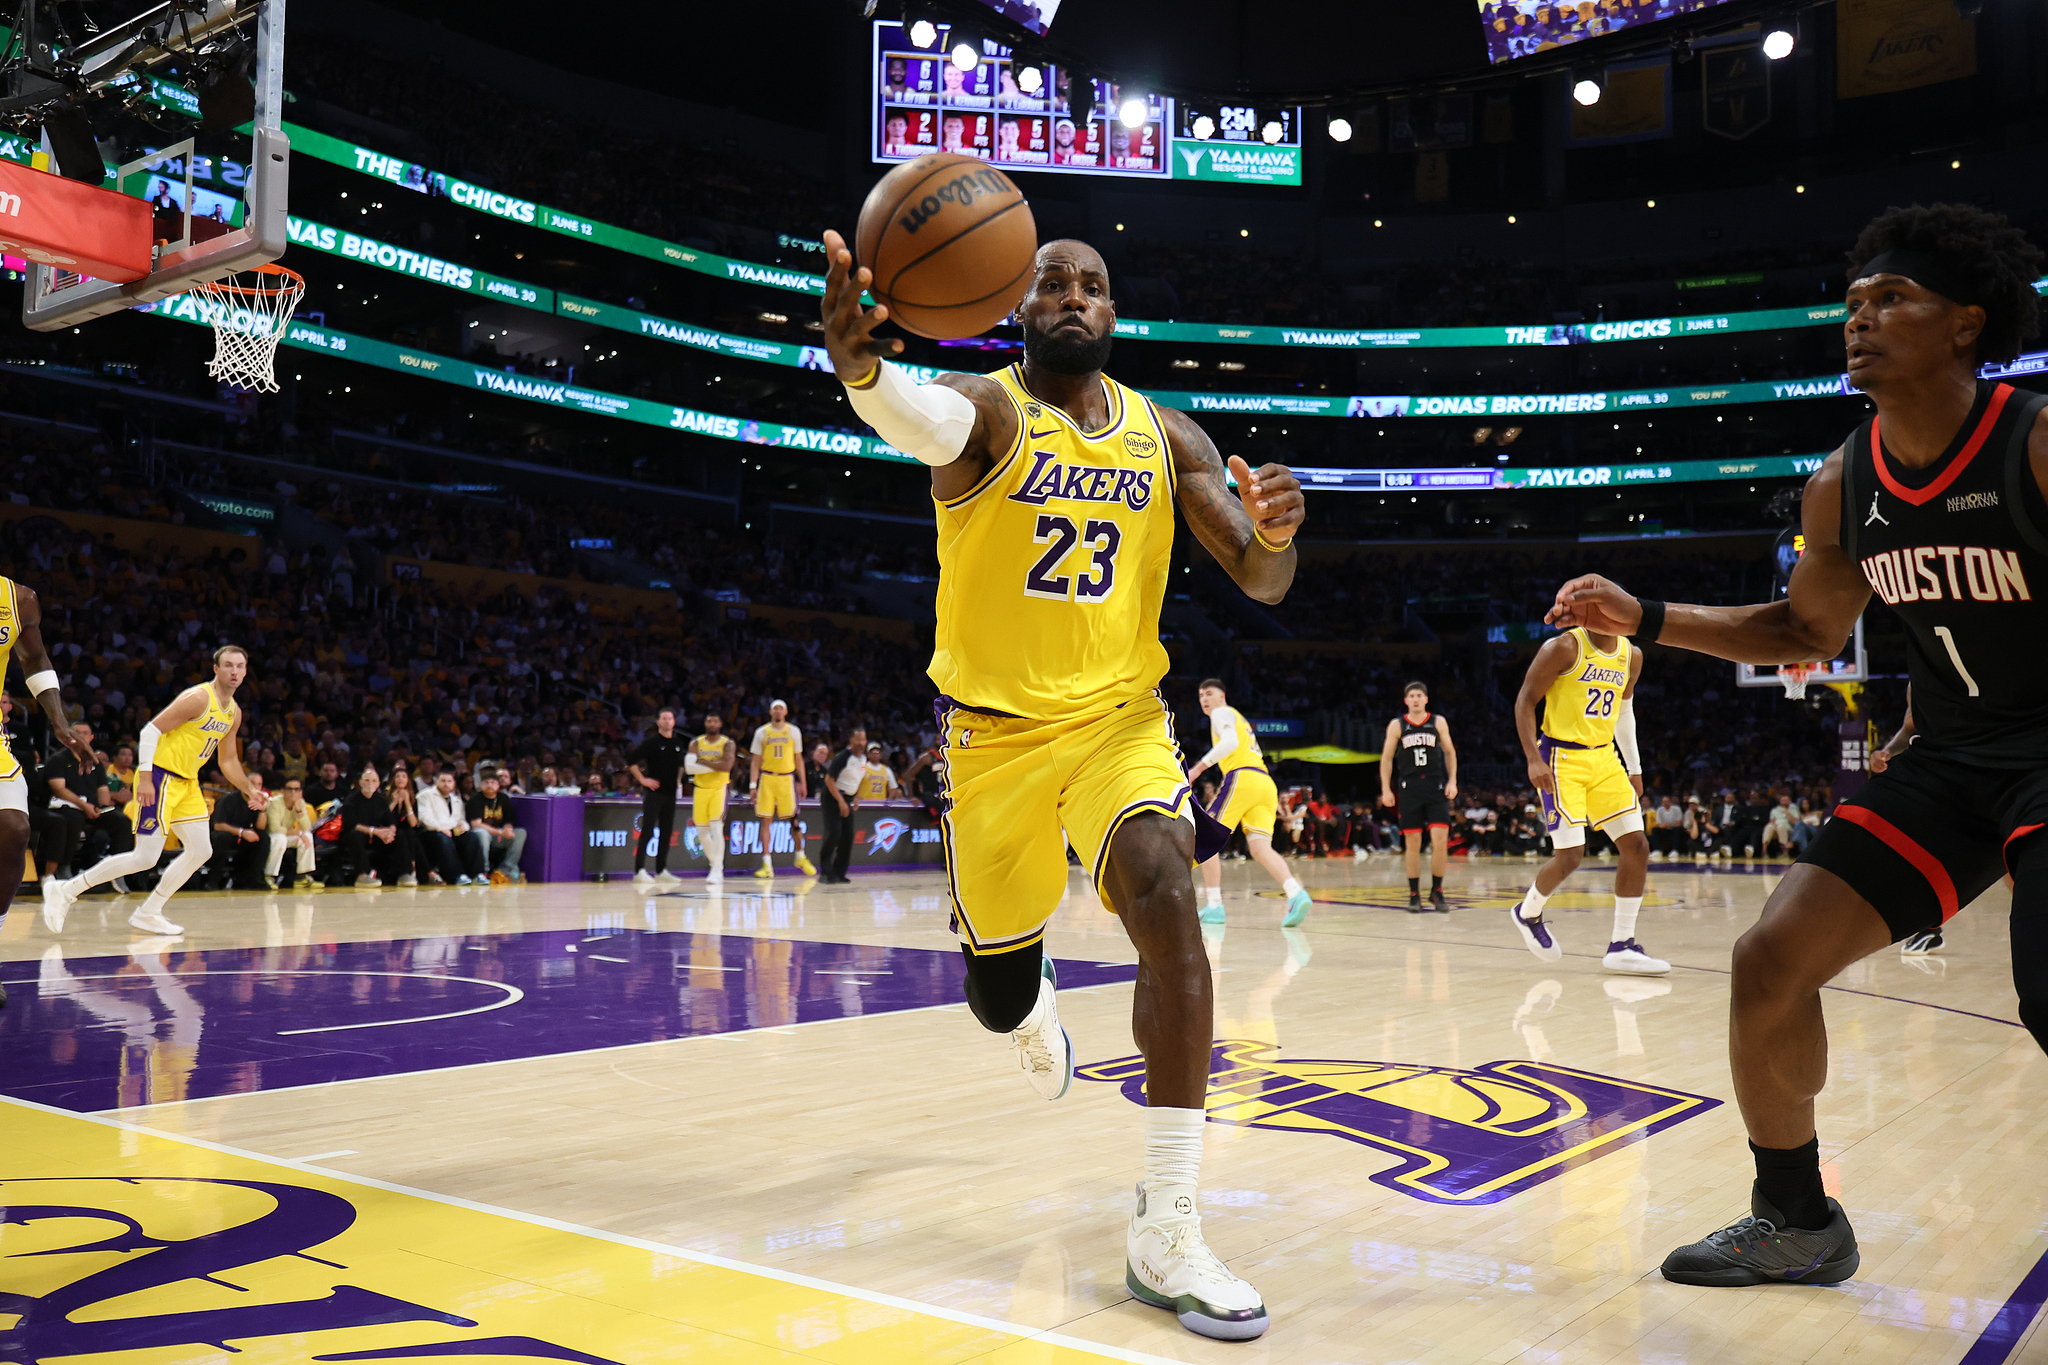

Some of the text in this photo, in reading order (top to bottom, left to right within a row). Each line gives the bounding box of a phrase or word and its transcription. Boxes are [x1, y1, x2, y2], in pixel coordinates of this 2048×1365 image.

[920, 60, 932, 80] 6
[1220, 106, 1255, 131] 2:54
[1211, 163, 1249, 173] RESORT
[354, 147, 593, 236] THE CHICKS JUNE 12
[899, 169, 1011, 234] Wilson
[341, 233, 474, 290] BROTHERS
[487, 281, 520, 299] APRIL
[521, 287, 537, 303] 30
[561, 301, 581, 314] YOU
[1808, 309, 1829, 320] YOU
[290, 327, 328, 348] APRIL
[331, 335, 347, 351] 26
[1504, 317, 1729, 344] THE CHICKS JUNE 12
[399, 354, 419, 368] YOU
[1414, 392, 1669, 415] JONAS BROTHERS APRIL 30
[1691, 390, 1711, 401] YOU
[669, 407, 740, 438] JAMES
[781, 425, 863, 454] TAYLOR
[1125, 436, 1154, 451] bibigo
[1386, 473, 1413, 487] 6:04
[1527, 466, 1672, 487] TAYLOR APRIL 26
[1719, 465, 1739, 475] YOU
[1006, 450, 1154, 512] LAKERS
[1946, 491, 1998, 505] MEMORIAL
[1947, 499, 1999, 513] HERMANN
[1024, 513, 1123, 603] 23
[1860, 545, 2032, 605] HOUSTON
[1933, 626, 1980, 697] 1
[1576, 662, 1625, 687] LAKERS
[1584, 687, 1615, 720] 28
[1256, 722, 1289, 733] ULTRA
[198, 737, 219, 759] 10
[1401, 732, 1436, 750] HOUSTON
[1413, 748, 1428, 767] 15
